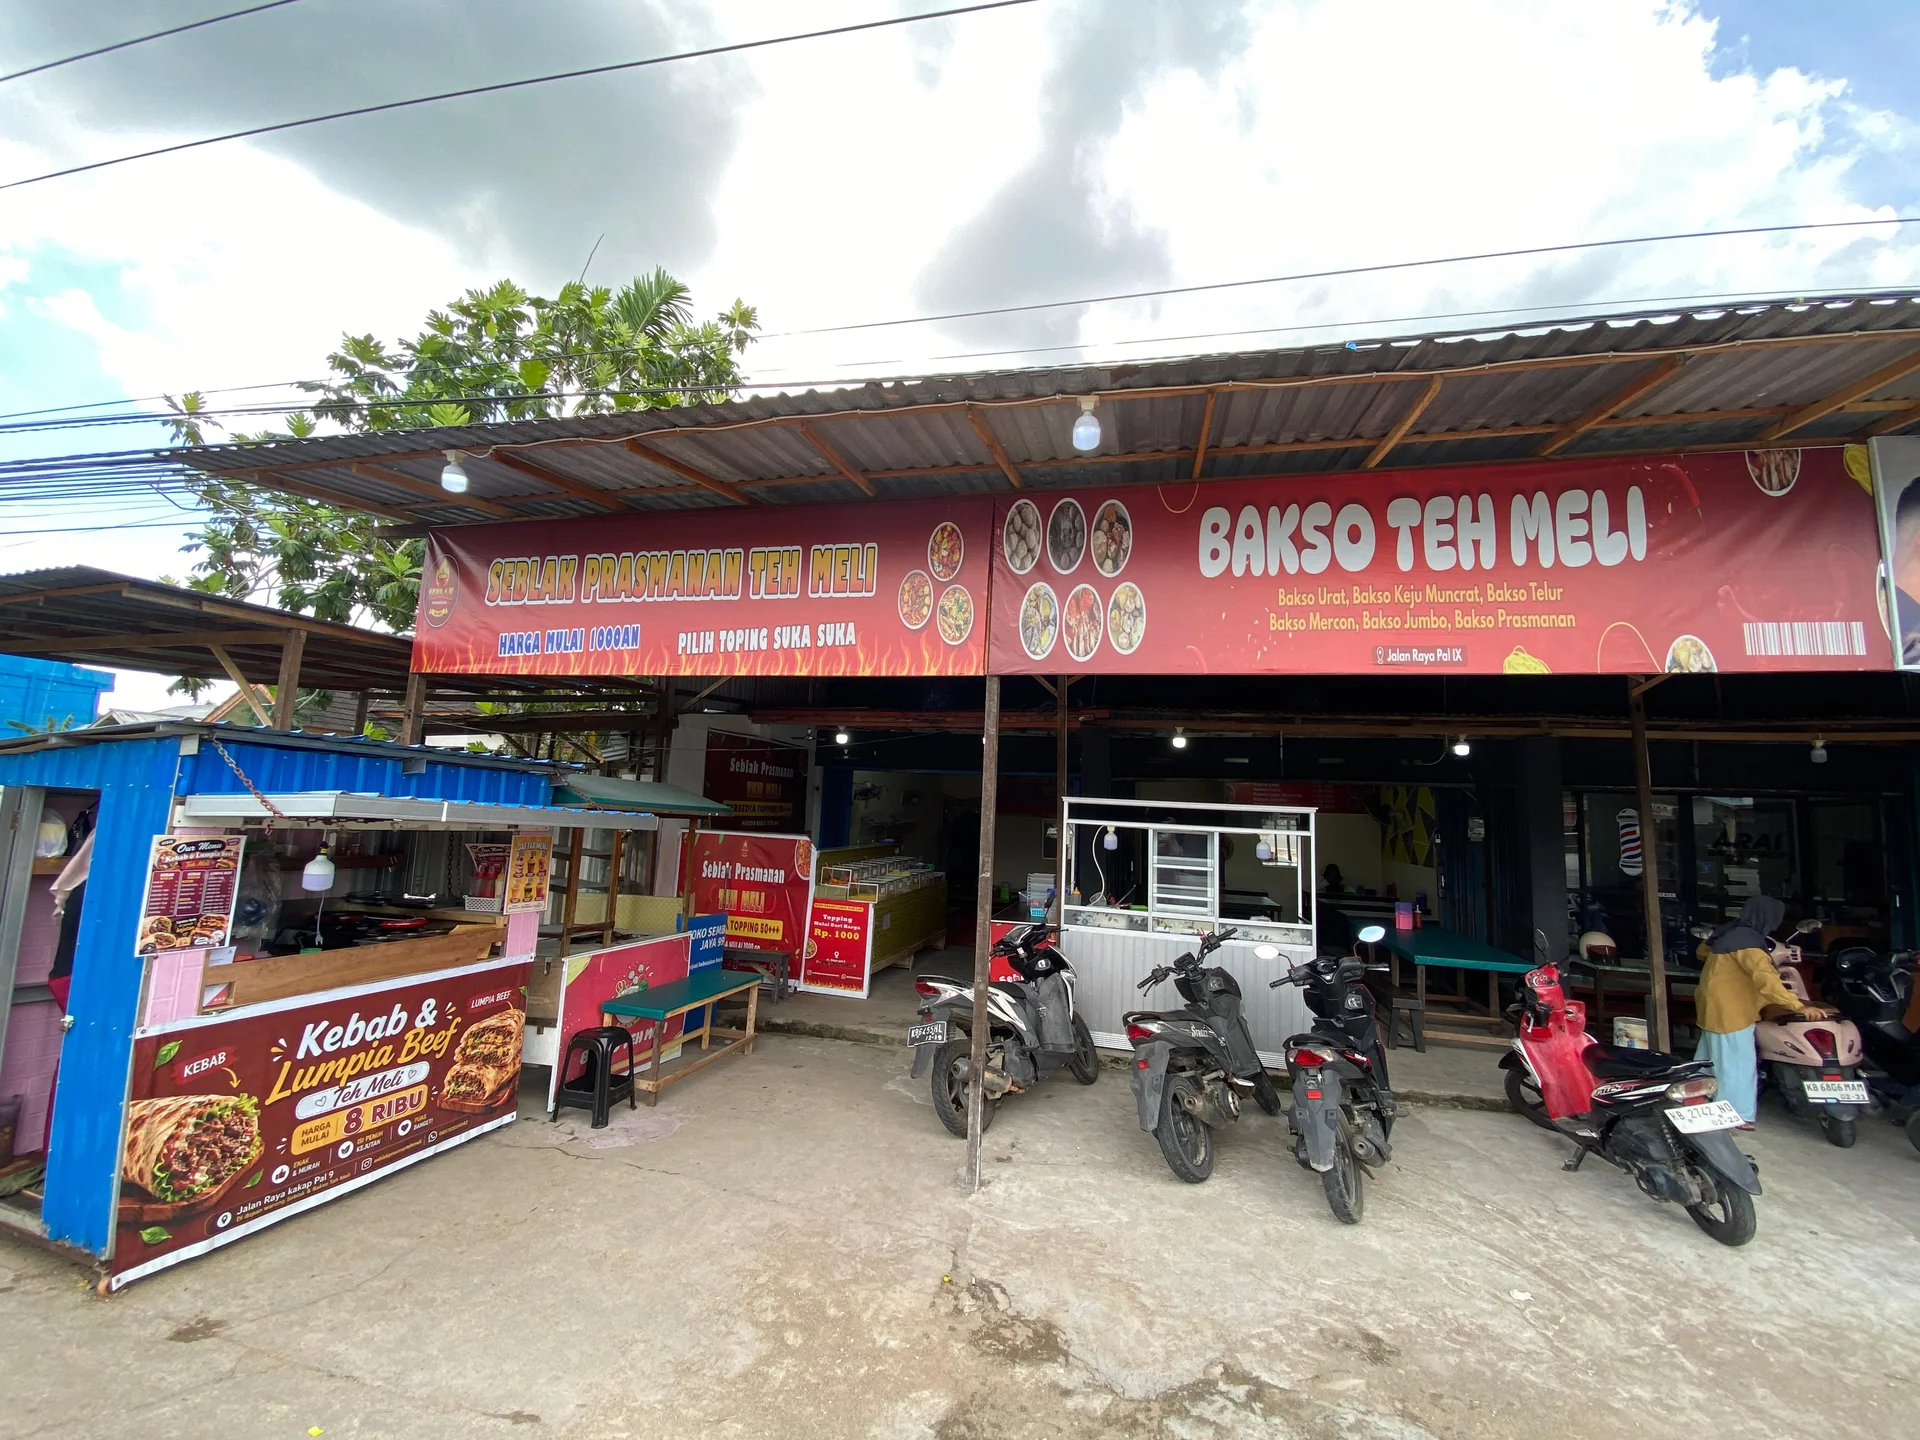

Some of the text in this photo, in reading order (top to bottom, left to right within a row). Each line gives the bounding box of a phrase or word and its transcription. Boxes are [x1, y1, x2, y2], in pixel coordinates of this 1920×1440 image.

[1198, 485, 1647, 578] BAKSO TEH MELI
[485, 543, 878, 606] SEBLAK PRASMANAN TEH MELI
[1278, 581, 1563, 609] Bakso Urat, Bakso Keju Muncrat, Bakso Telur
[1269, 608, 1576, 633] Bakso Mercon, Bakso Jumbo, Bakso Prasmanan
[498, 624, 641, 657] HARGA MULAI 1000AN
[677, 622, 856, 655] PILIH TOPING SUKA SUKA
[1386, 649, 1463, 665] Jalan Raya Pal IX
[730, 757, 794, 779] Seblak Prasmanan
[177, 843, 196, 853] Our
[198, 841, 222, 850] Menu
[164, 854, 189, 863] Kebab
[734, 863, 785, 883] Prasmanan
[740, 890, 765, 913] MELI
[730, 920, 759, 933] TOPPING
[760, 923, 780, 934] 50+++
[823, 914, 853, 923] Topping
[814, 928, 860, 940] Rp. 1000
[700, 938, 716, 950] JAYA
[471, 990, 512, 1008] LUMPIA BEEF
[296, 998, 437, 1060] Kebab &
[644, 1022, 668, 1041] MI
[184, 1052, 226, 1077] KEBAB
[265, 1017, 461, 1106] Lumpia Beef
[333, 1070, 403, 1108] Teh Meli
[1806, 1083, 1864, 1092] KB 6806 MAM
[342, 1088, 424, 1136] 8 RIBU
[1669, 1110, 1684, 1121] KB
[1689, 1106, 1714, 1119] 2742
[300, 1130, 330, 1147] MULAI
[301, 1121, 331, 1138] HARGA
[356, 1139, 382, 1152] KEJUTAN
[293, 1157, 310, 1169] ENAK
[298, 1161, 320, 1175] MURAH
[236, 1170, 334, 1215] Jalan Raya kakap Pal 9
